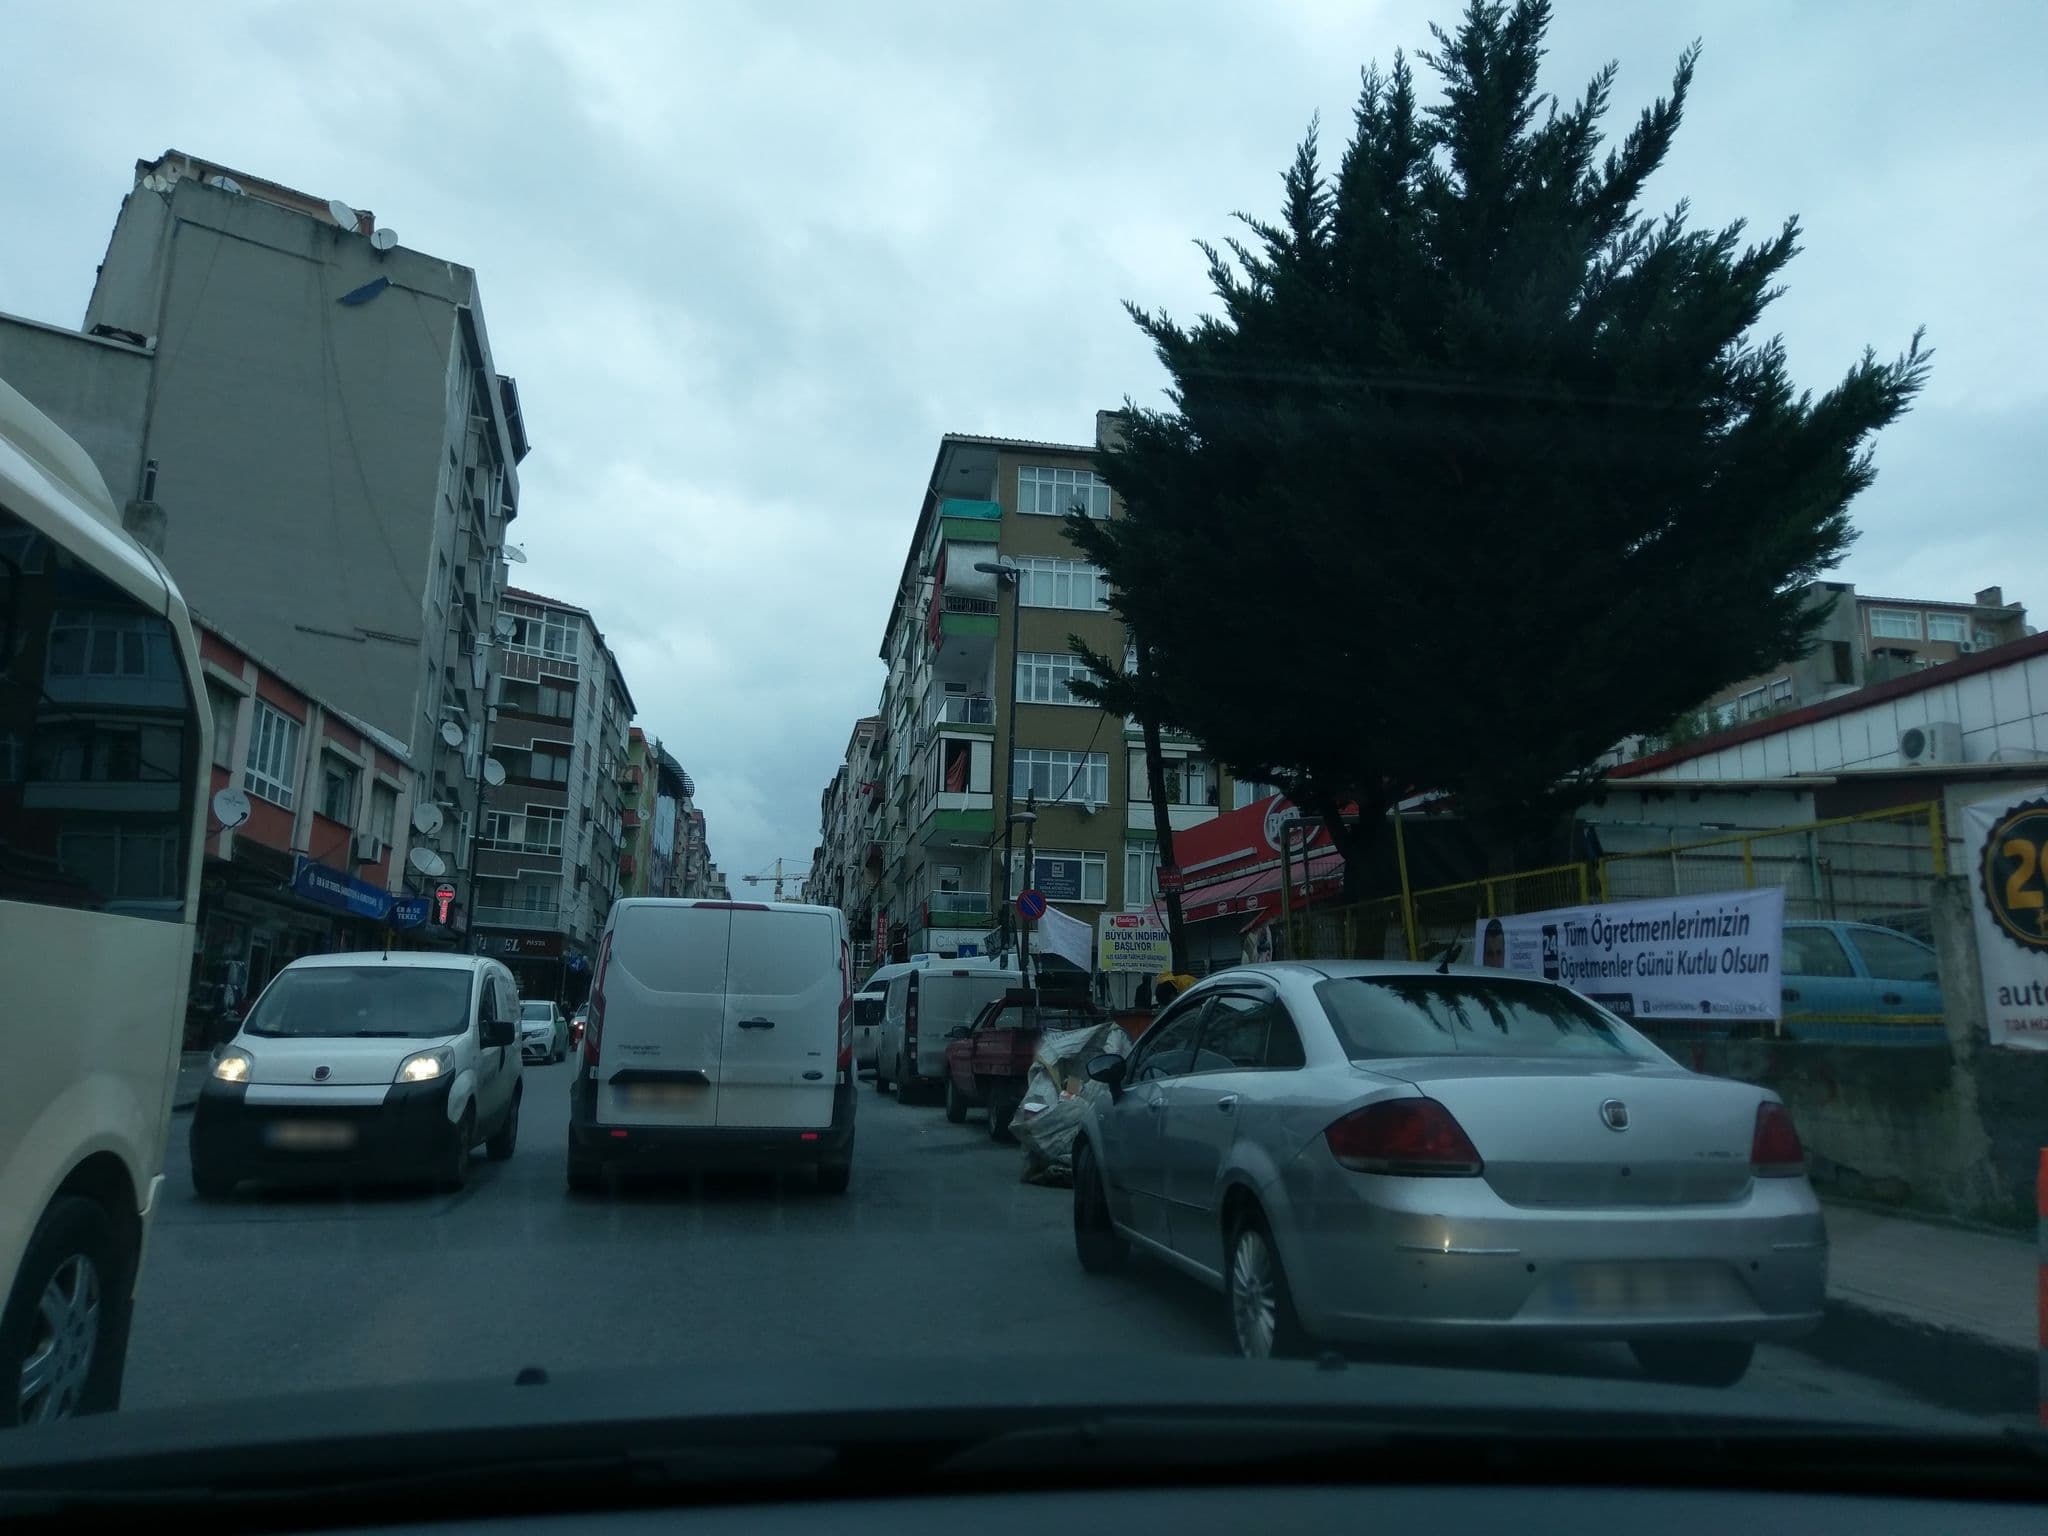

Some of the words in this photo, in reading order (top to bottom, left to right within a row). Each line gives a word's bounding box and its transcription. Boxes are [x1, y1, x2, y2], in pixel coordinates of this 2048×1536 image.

[2003, 838, 2048, 910] 2
[1105, 929, 1133, 941] BÜYÜK
[1136, 929, 1168, 942] İNDİRİM
[1563, 921, 1588, 948] Tüm
[1591, 906, 1750, 952] Öğretmenlerimizin
[1115, 942, 1152, 953] BAŞLIYOR
[1543, 934, 1558, 956] 24
[1560, 952, 1634, 985] Öğretmenler
[1636, 951, 1674, 977] Günü
[1677, 948, 1717, 976] Kutlu
[1721, 946, 1769, 974] Olsun
